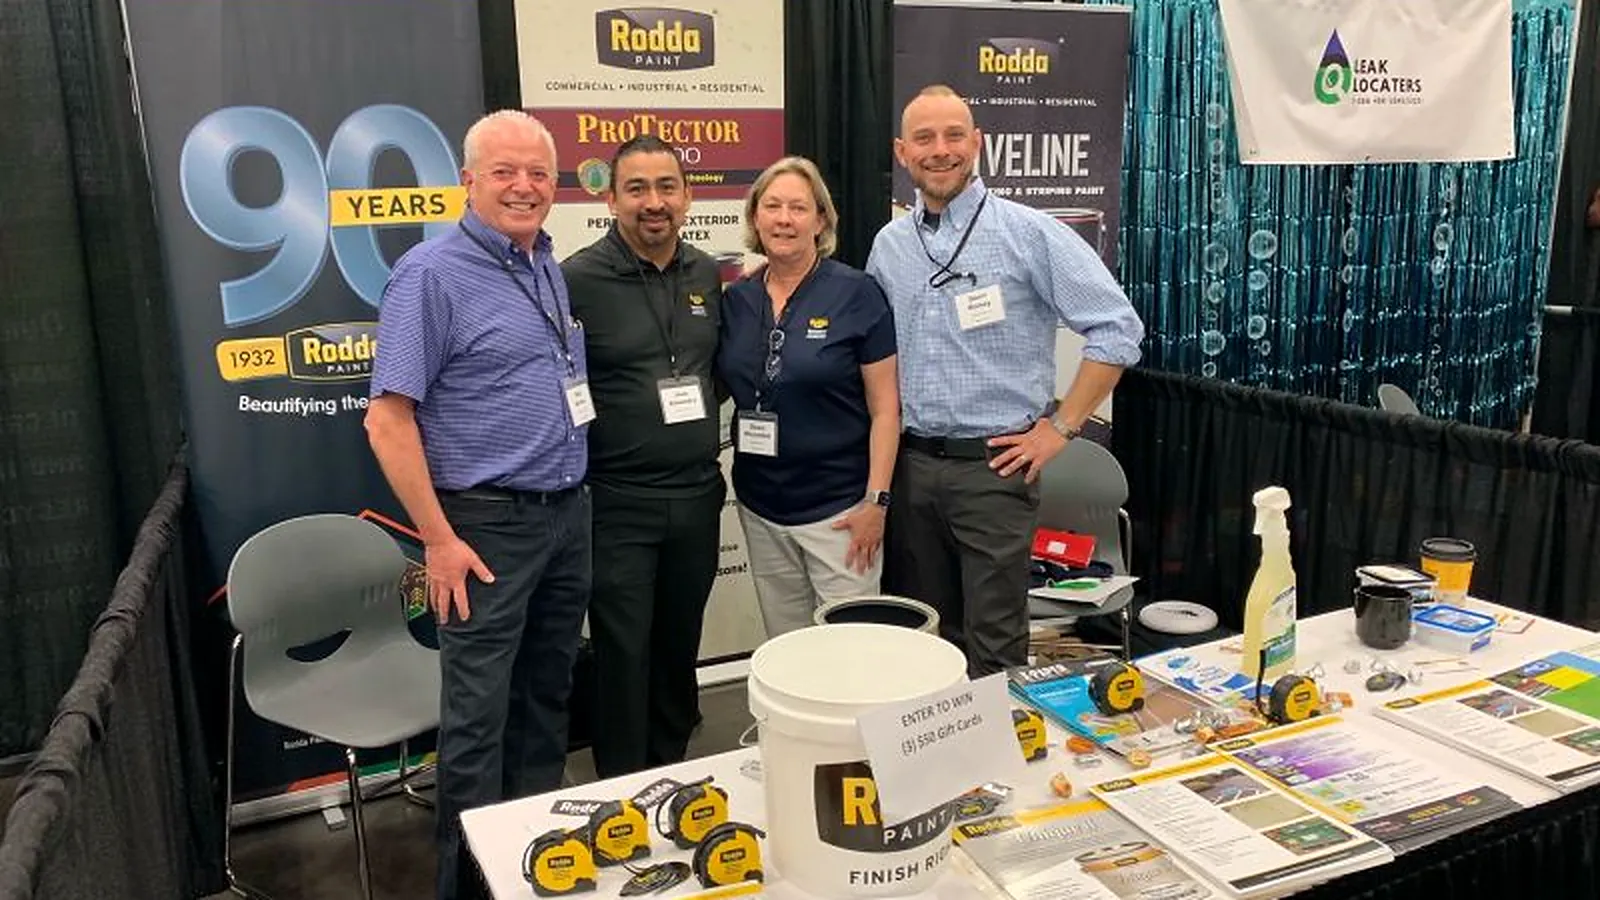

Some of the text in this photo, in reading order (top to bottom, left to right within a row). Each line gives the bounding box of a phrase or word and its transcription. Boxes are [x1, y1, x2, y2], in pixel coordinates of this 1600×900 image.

[611, 18, 700, 53] Rodda
[635, 55, 681, 66] PAINT
[979, 47, 1049, 73] Rodda
[1354, 59, 1389, 74] LEAK
[545, 81, 765, 93] COMMERCIAL INDUSTRIAL RESIDENTIAL
[997, 76, 1033, 84] PAINT
[1353, 78, 1422, 93] LOCATERS
[1045, 97, 1097, 106] RESIDENTIAL
[1074, 186, 1105, 195] PAINT
[180, 103, 461, 327] 90
[348, 193, 446, 219] YEARS
[679, 231, 710, 241] ATEX
[230, 350, 275, 369] 1932
[238, 394, 369, 416] Beautifying the
[901, 691, 973, 727] ENTER TO WIN
[937, 723, 956, 739] Gift
[957, 712, 983, 731] Cards
[559, 801, 599, 815] Rodd
[883, 810, 948, 845] PAINT
[849, 862, 919, 886] FINISH
